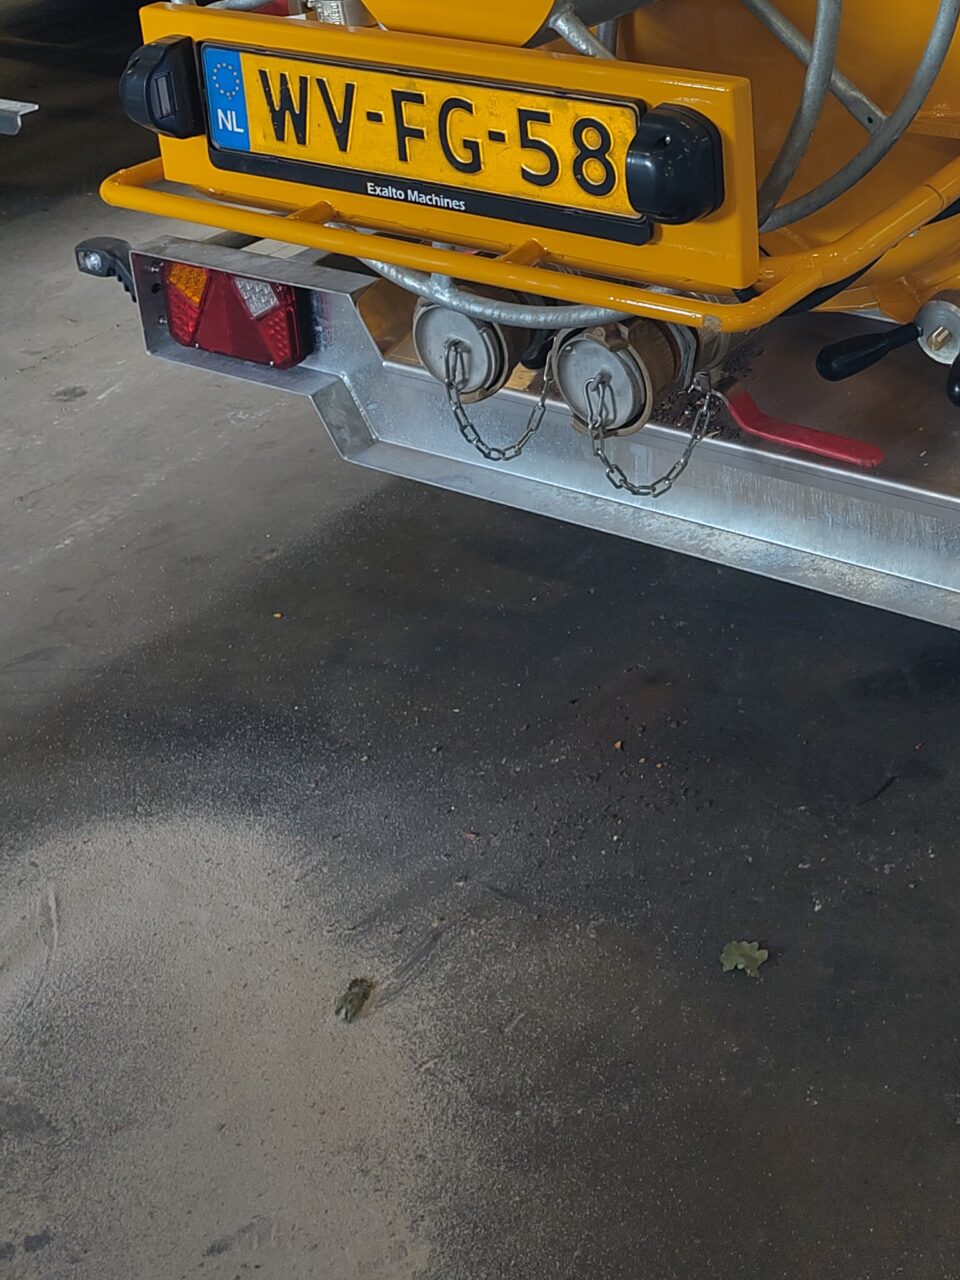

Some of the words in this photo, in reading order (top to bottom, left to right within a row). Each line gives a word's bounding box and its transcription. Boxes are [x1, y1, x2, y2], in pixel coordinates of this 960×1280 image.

[217, 108, 245, 133] NL
[257, 68, 618, 197] WV-FG-58
[366, 182, 405, 200] Exalto
[407, 189, 466, 211] Machines
